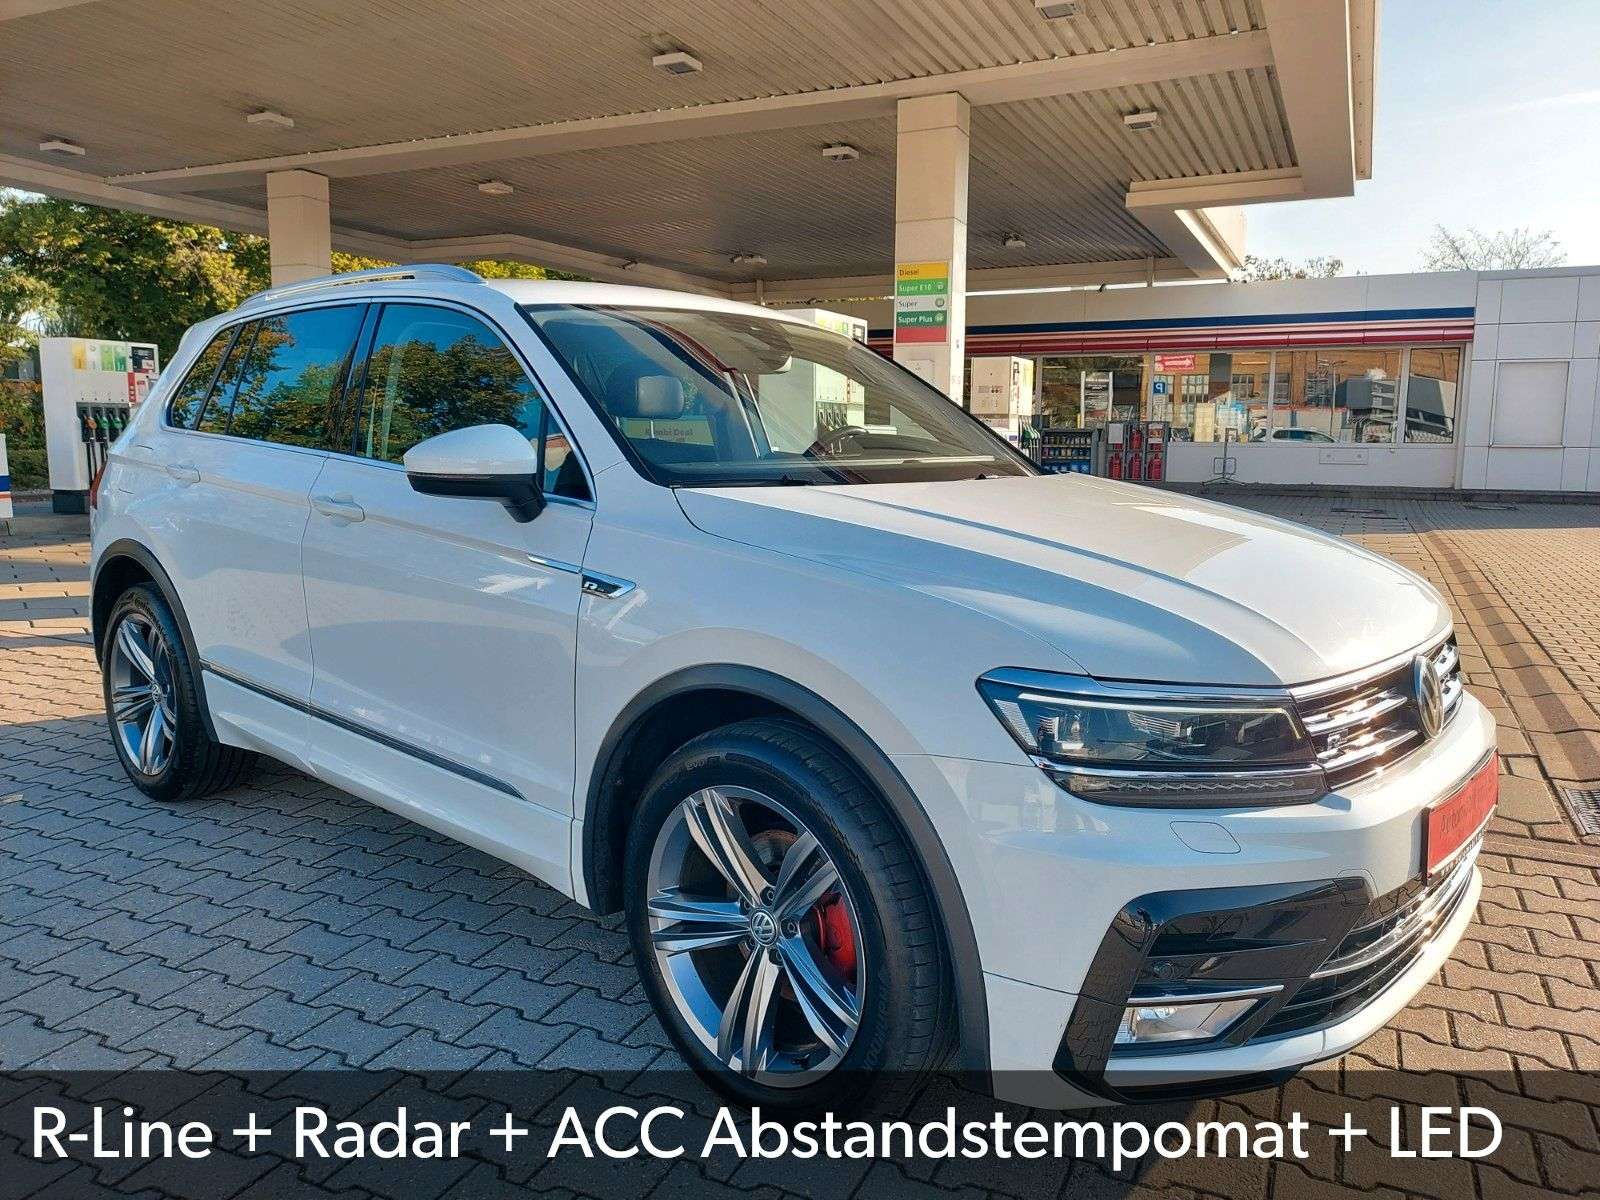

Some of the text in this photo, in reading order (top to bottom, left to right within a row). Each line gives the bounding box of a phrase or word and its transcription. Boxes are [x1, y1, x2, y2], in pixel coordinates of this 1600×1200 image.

[920, 283, 932, 291] E10
[898, 317, 918, 325] Super
[919, 315, 933, 323] Plus
